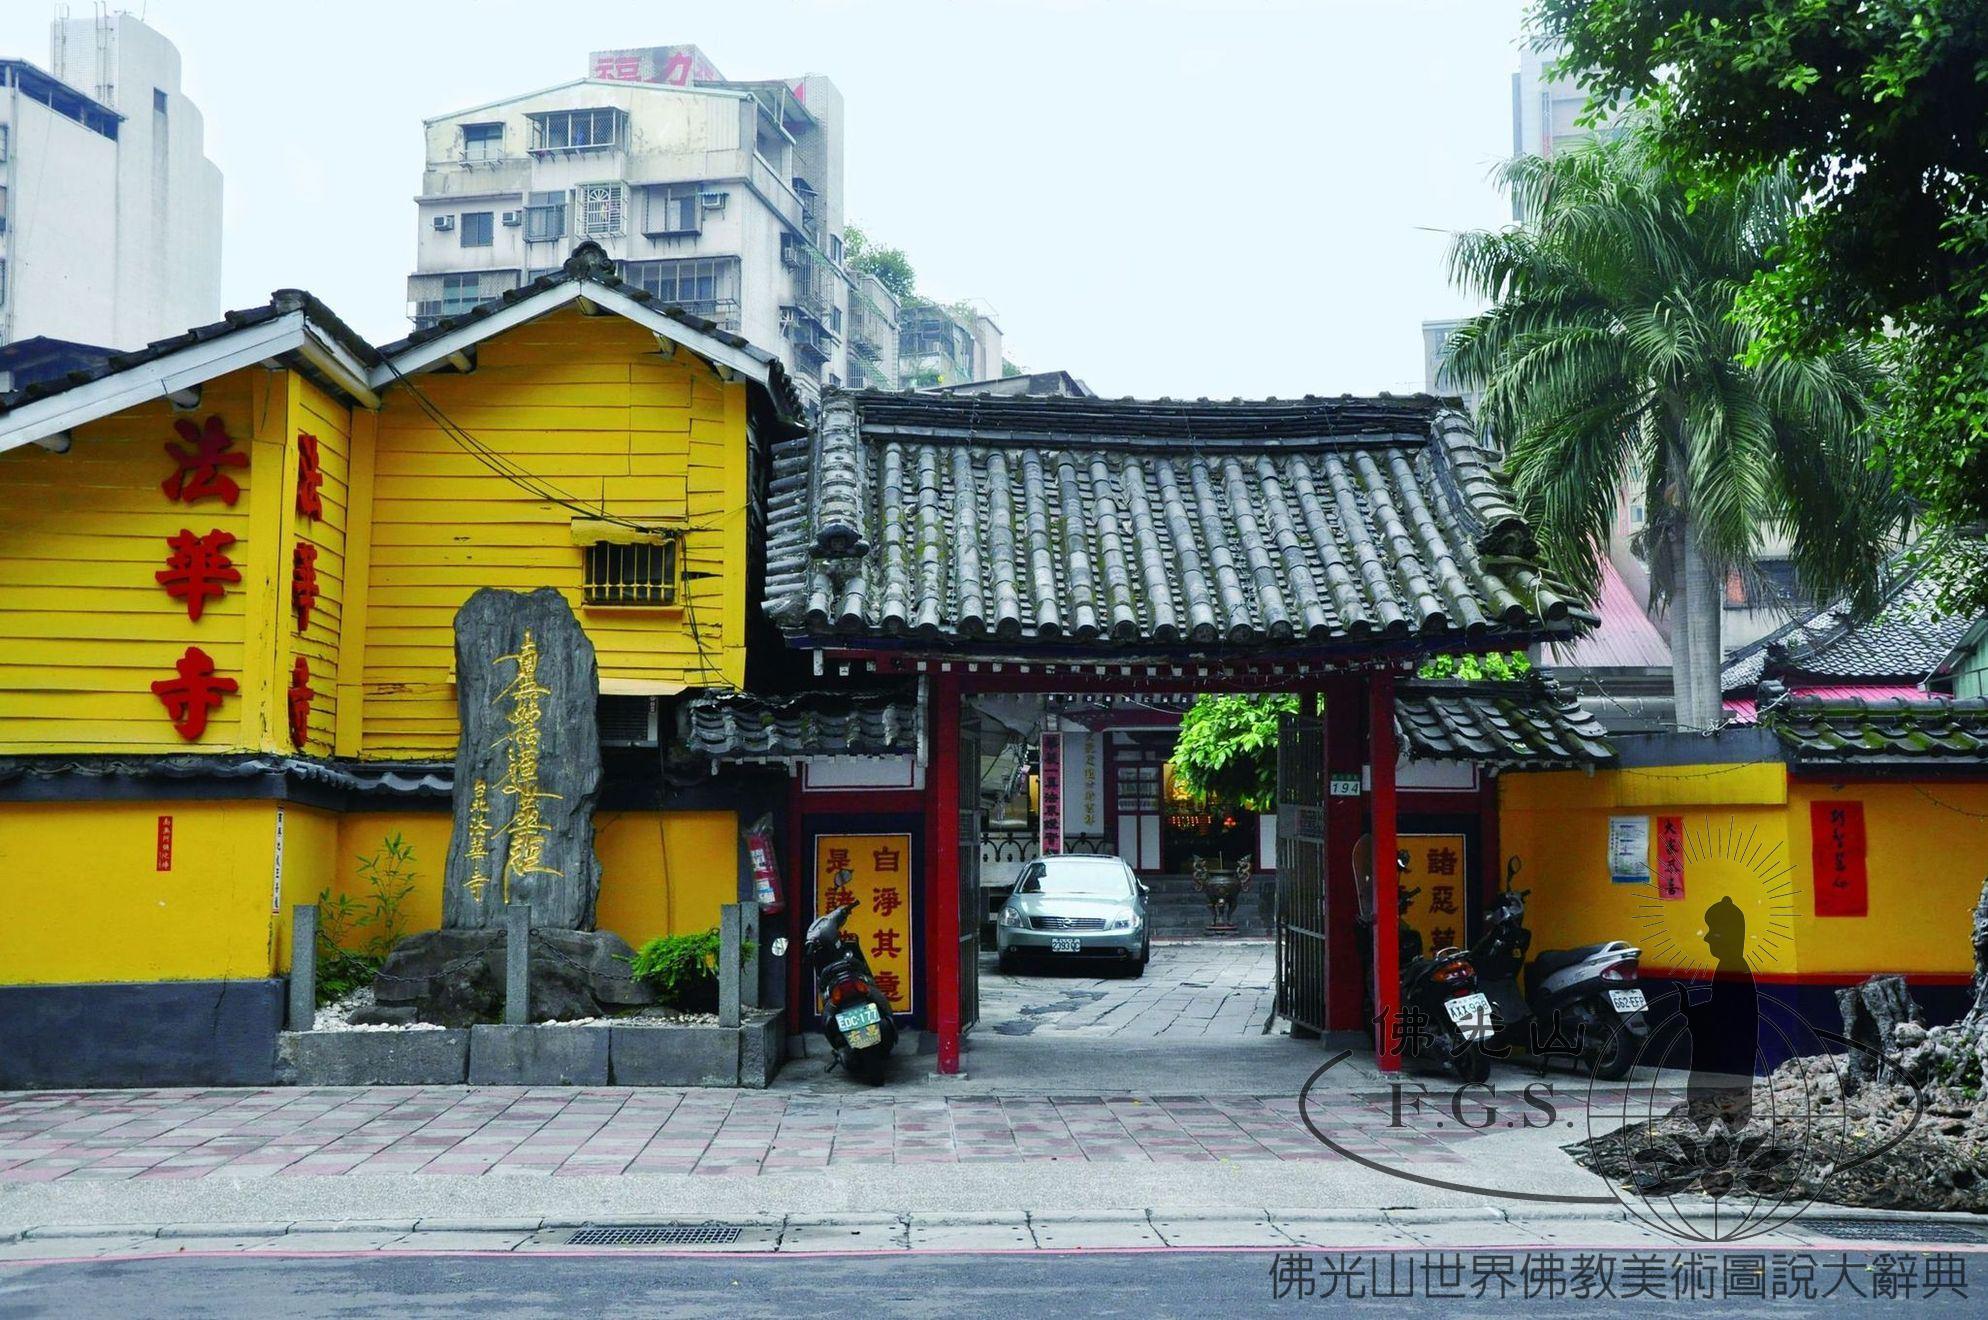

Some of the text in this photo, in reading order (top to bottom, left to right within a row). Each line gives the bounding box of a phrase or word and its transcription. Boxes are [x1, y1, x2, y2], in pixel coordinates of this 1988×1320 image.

[151, 414, 250, 742] 法華寺
[288, 434, 323, 748] 法華寺
[1332, 782, 1359, 794] 194
[870, 847, 903, 1003] 自淨其意
